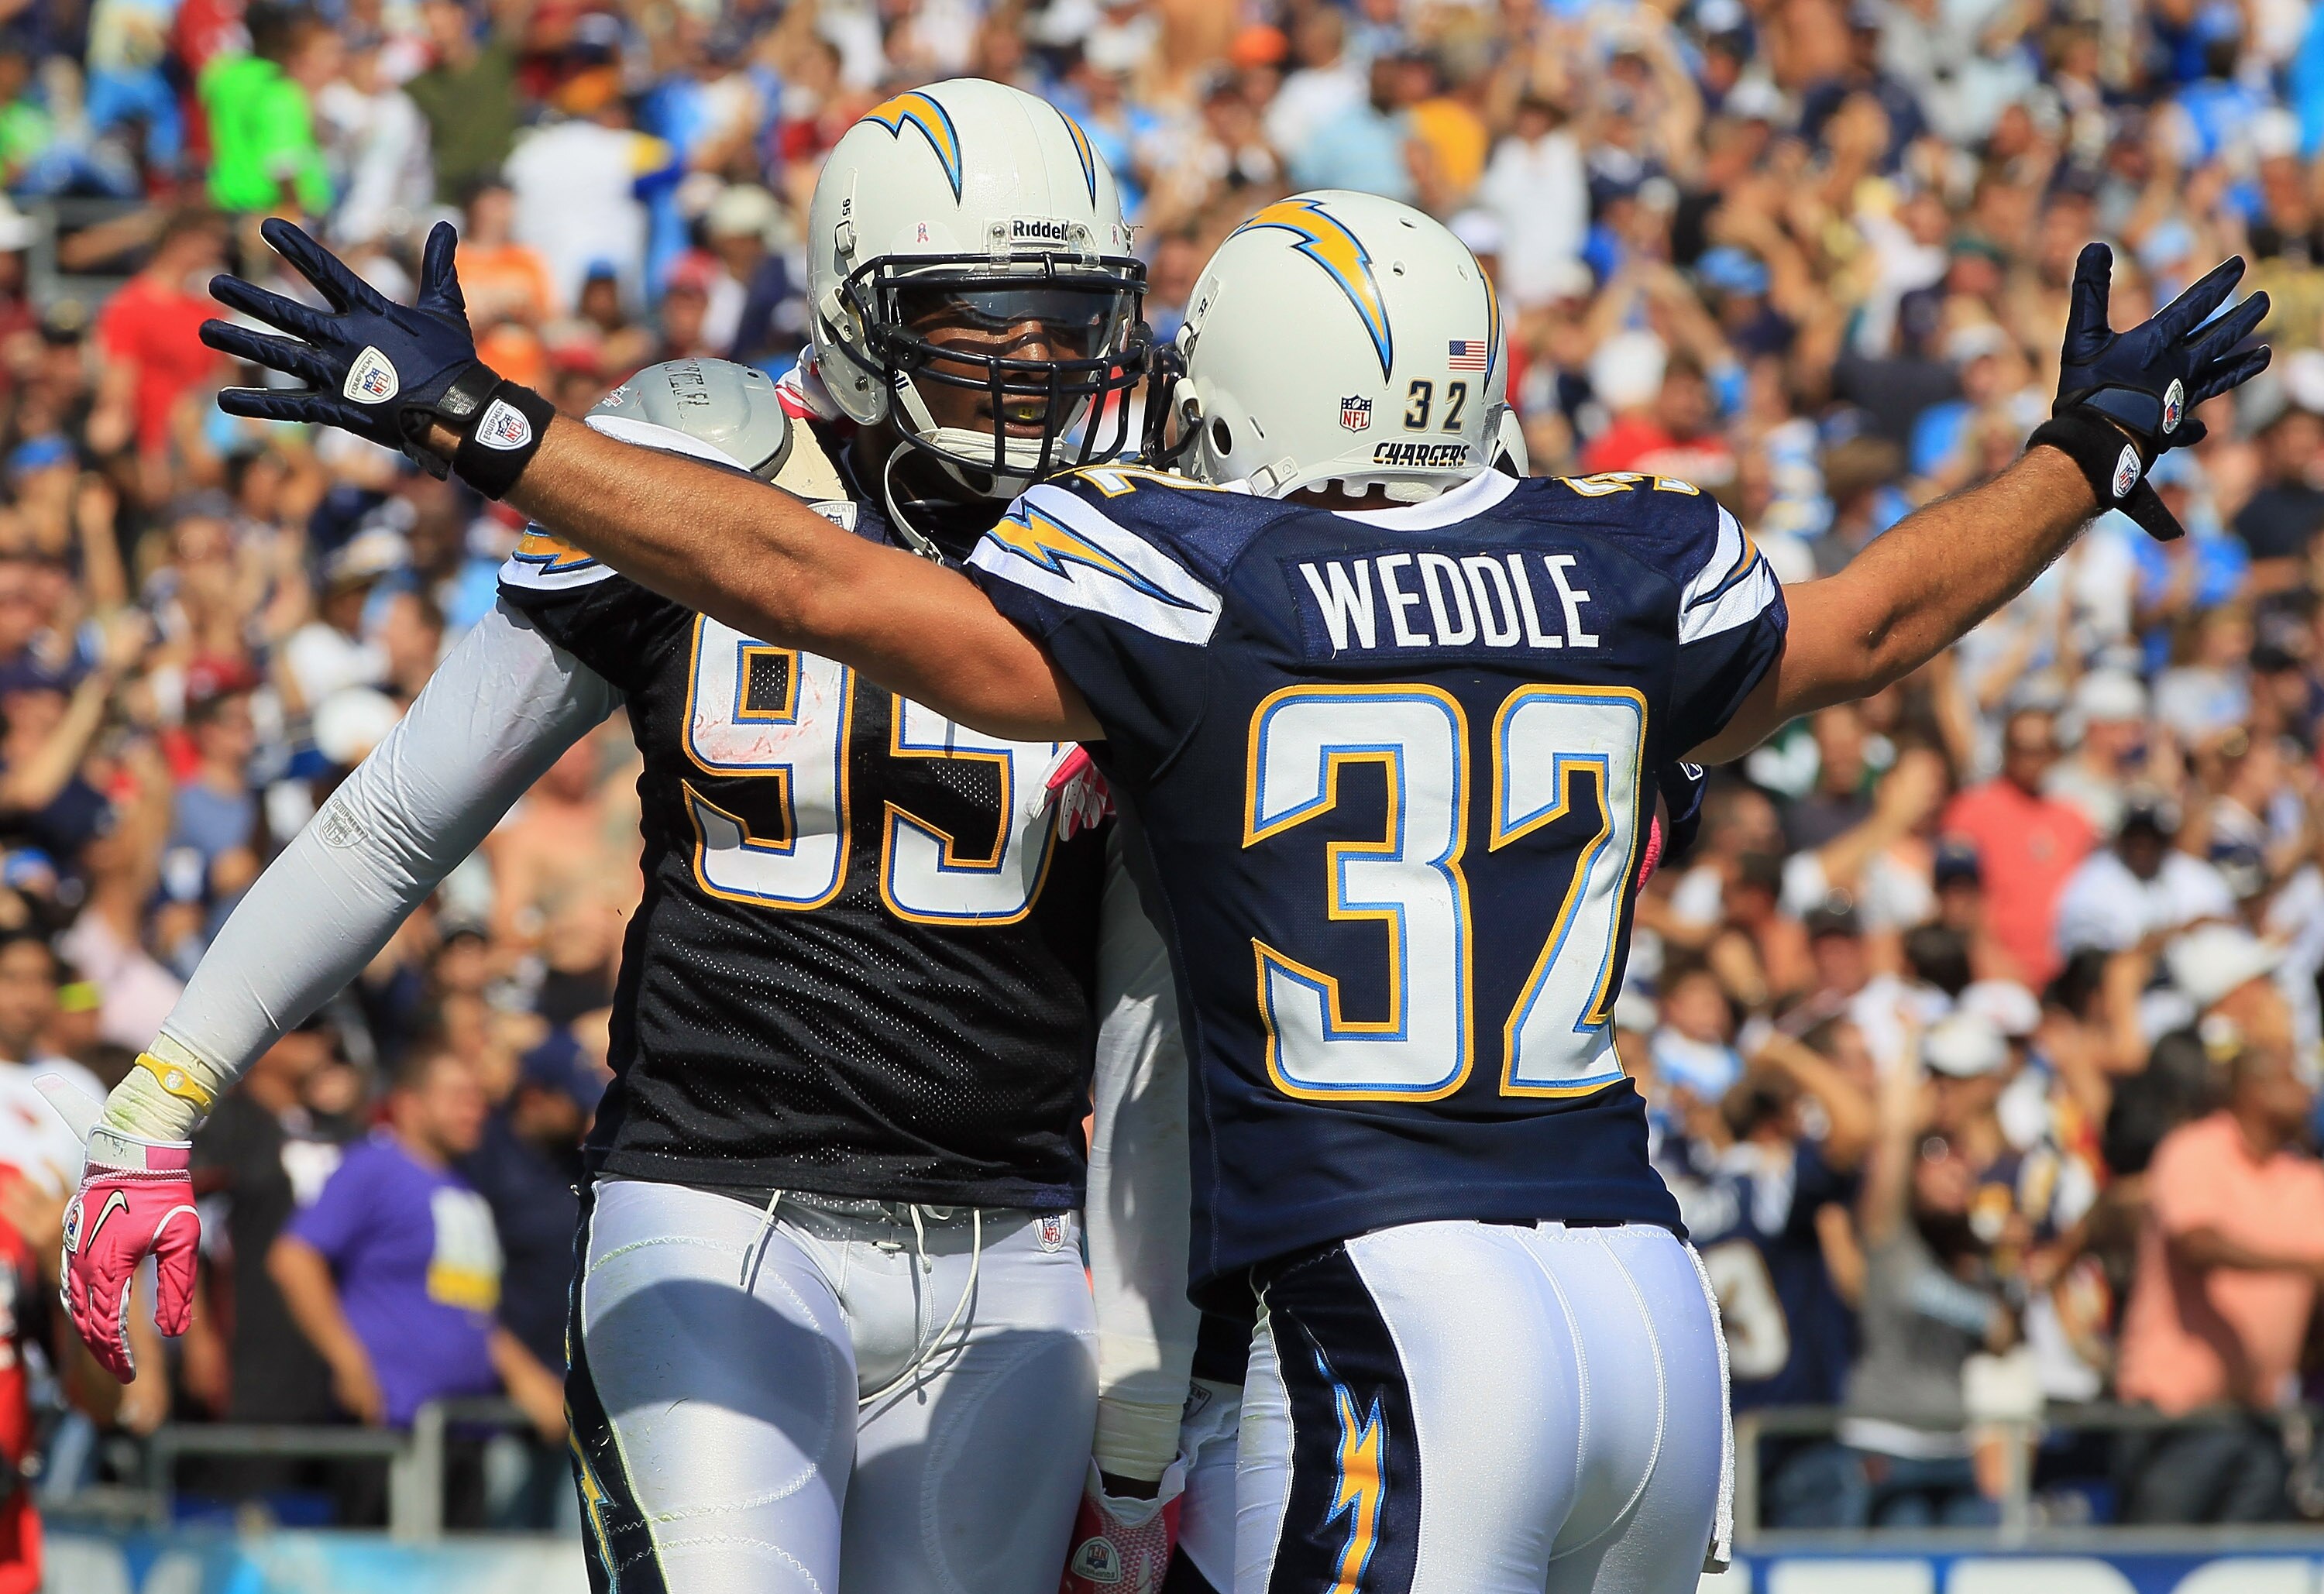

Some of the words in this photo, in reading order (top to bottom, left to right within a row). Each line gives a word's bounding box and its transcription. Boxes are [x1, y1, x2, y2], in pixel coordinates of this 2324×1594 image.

[842, 198, 851, 216] 95
[1198, 297, 1208, 318] 32
[350, 356, 375, 395] EQUIPMENT
[372, 374, 390, 395] NFL
[483, 403, 508, 441] EQUIPMENT
[1342, 411, 1369, 428] NFL
[1402, 377, 1470, 434] 32
[504, 421, 524, 441] NFL
[1373, 441, 1471, 467] CHARGERS
[1297, 552, 1600, 651] WEDDLE
[681, 612, 1064, 927] 95
[332, 801, 365, 837] EQUIPMENT
[1241, 683, 1648, 1103] 32
